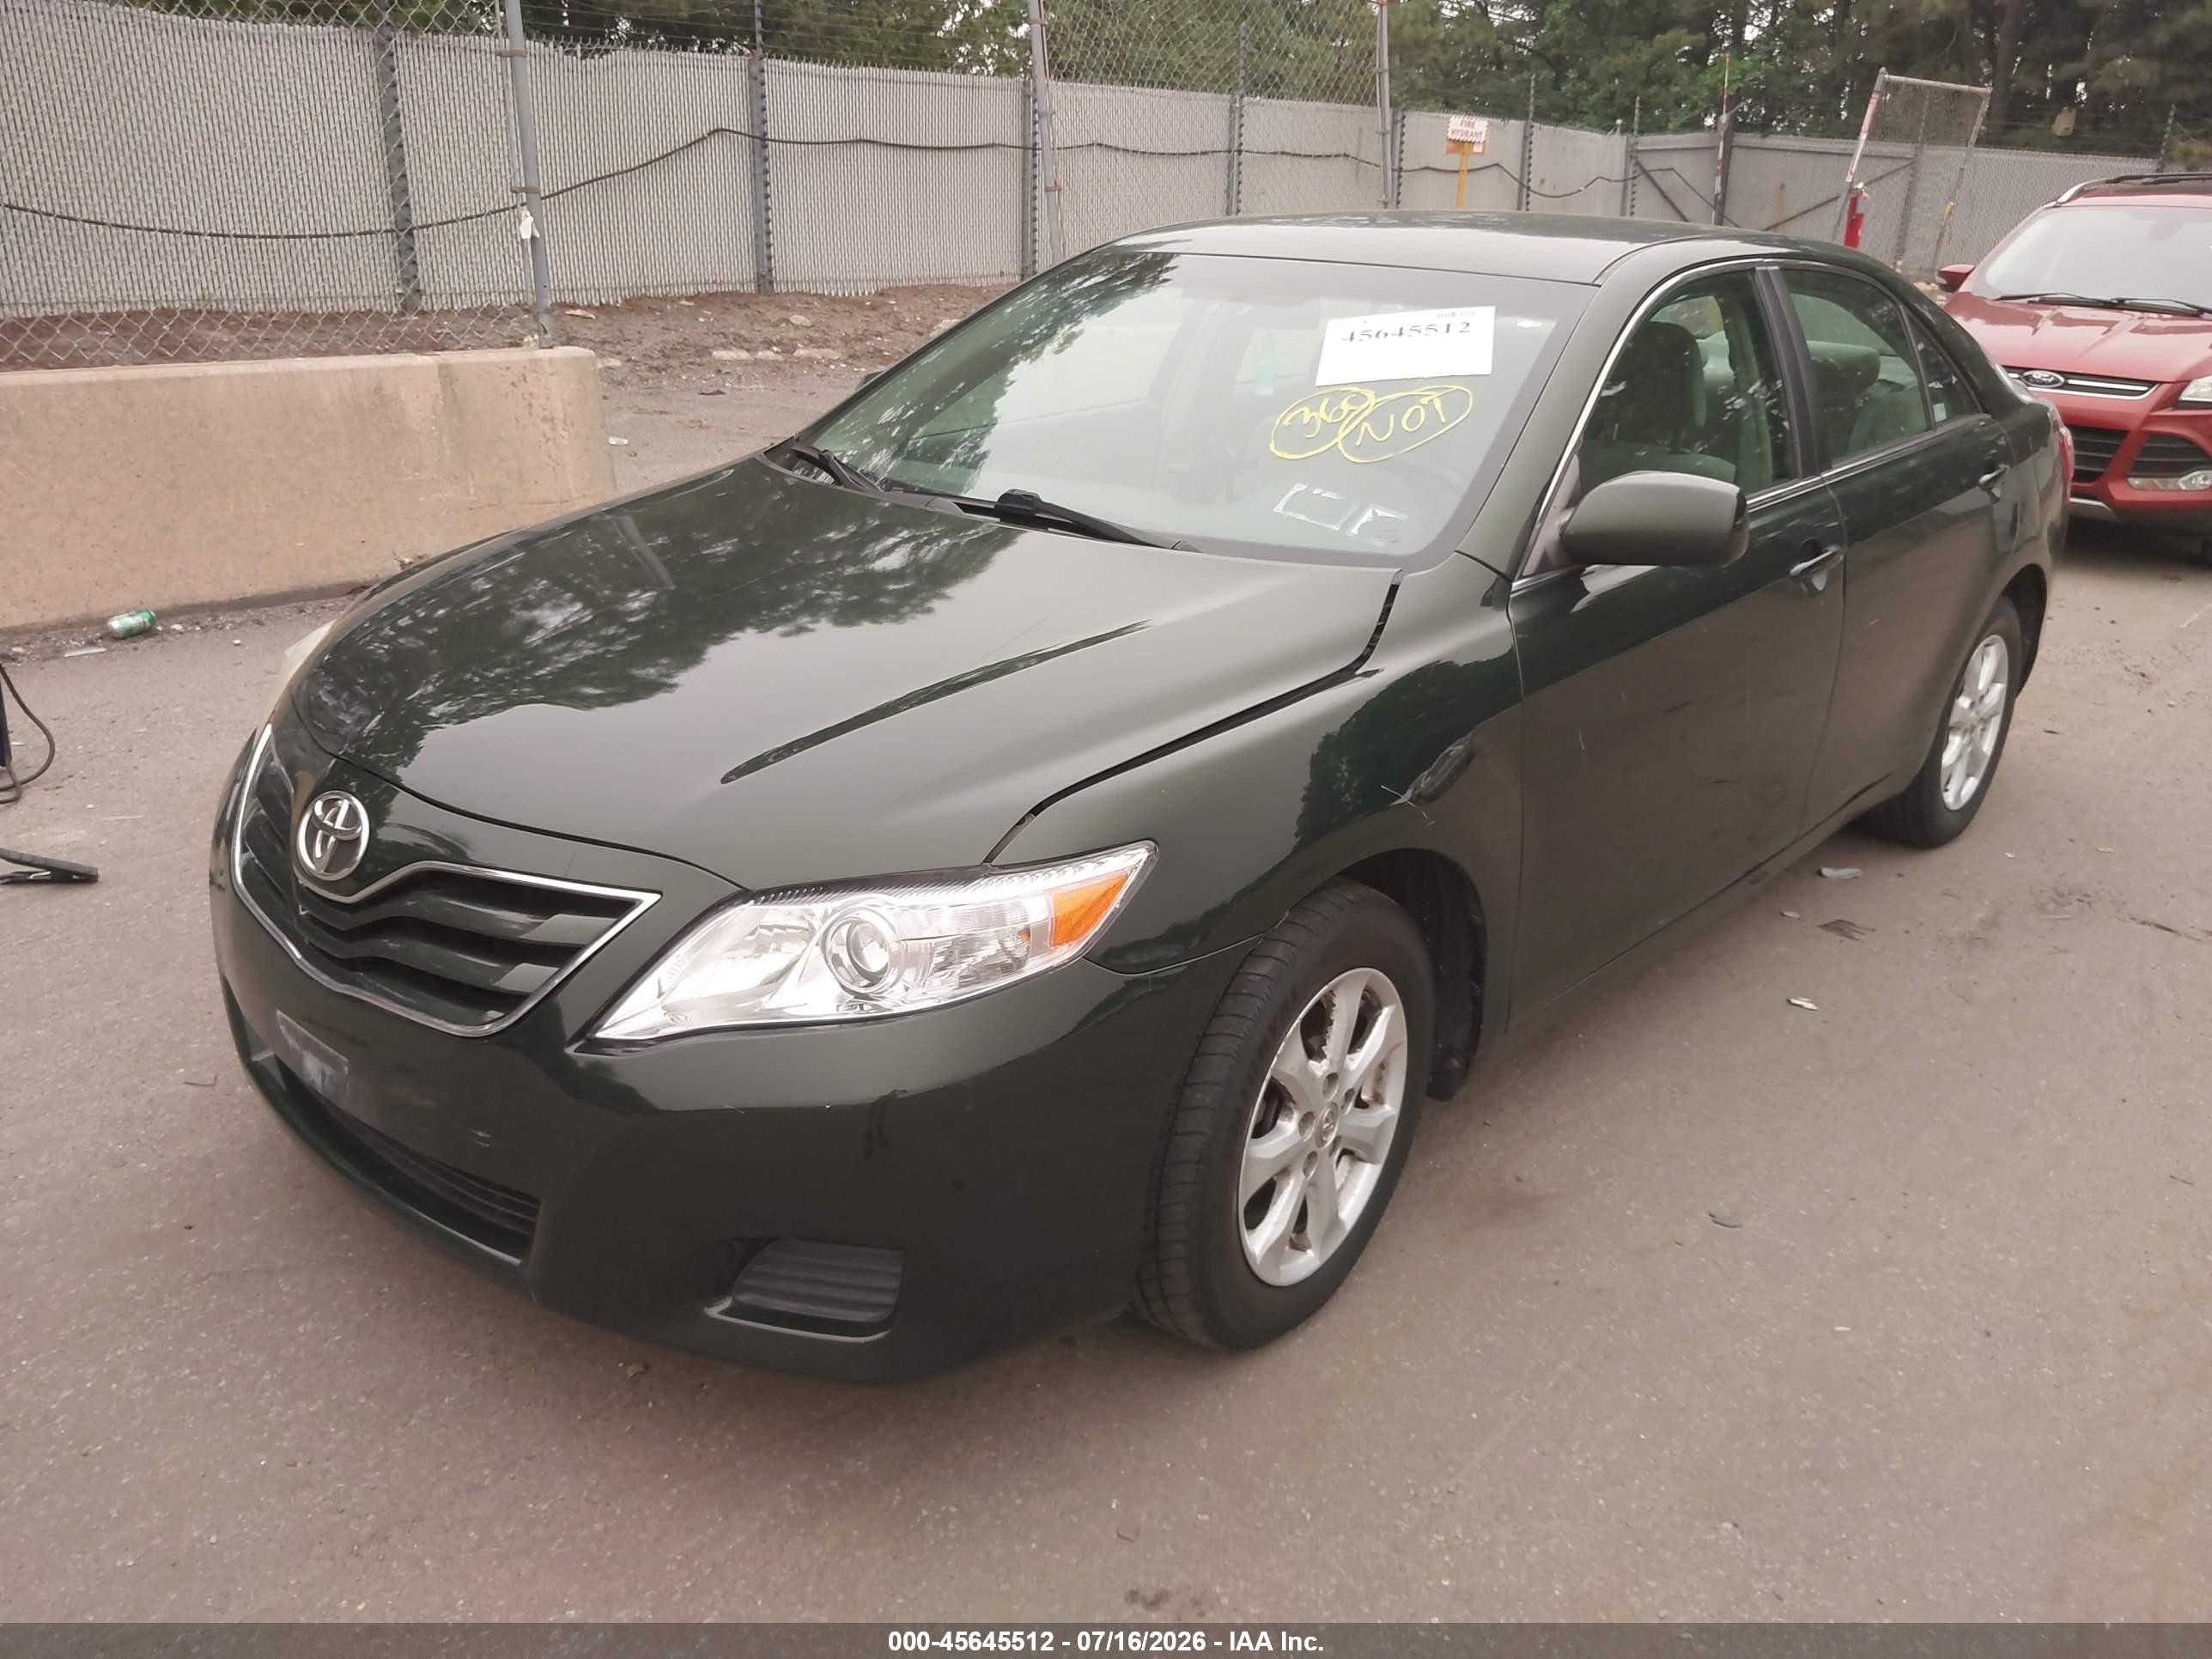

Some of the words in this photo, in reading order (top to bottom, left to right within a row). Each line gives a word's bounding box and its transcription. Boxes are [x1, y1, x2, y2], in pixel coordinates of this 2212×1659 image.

[1460, 119, 1475, 130] FIRE
[1451, 129, 1483, 140] HYDRANT
[1341, 322, 1471, 342] 45645512
